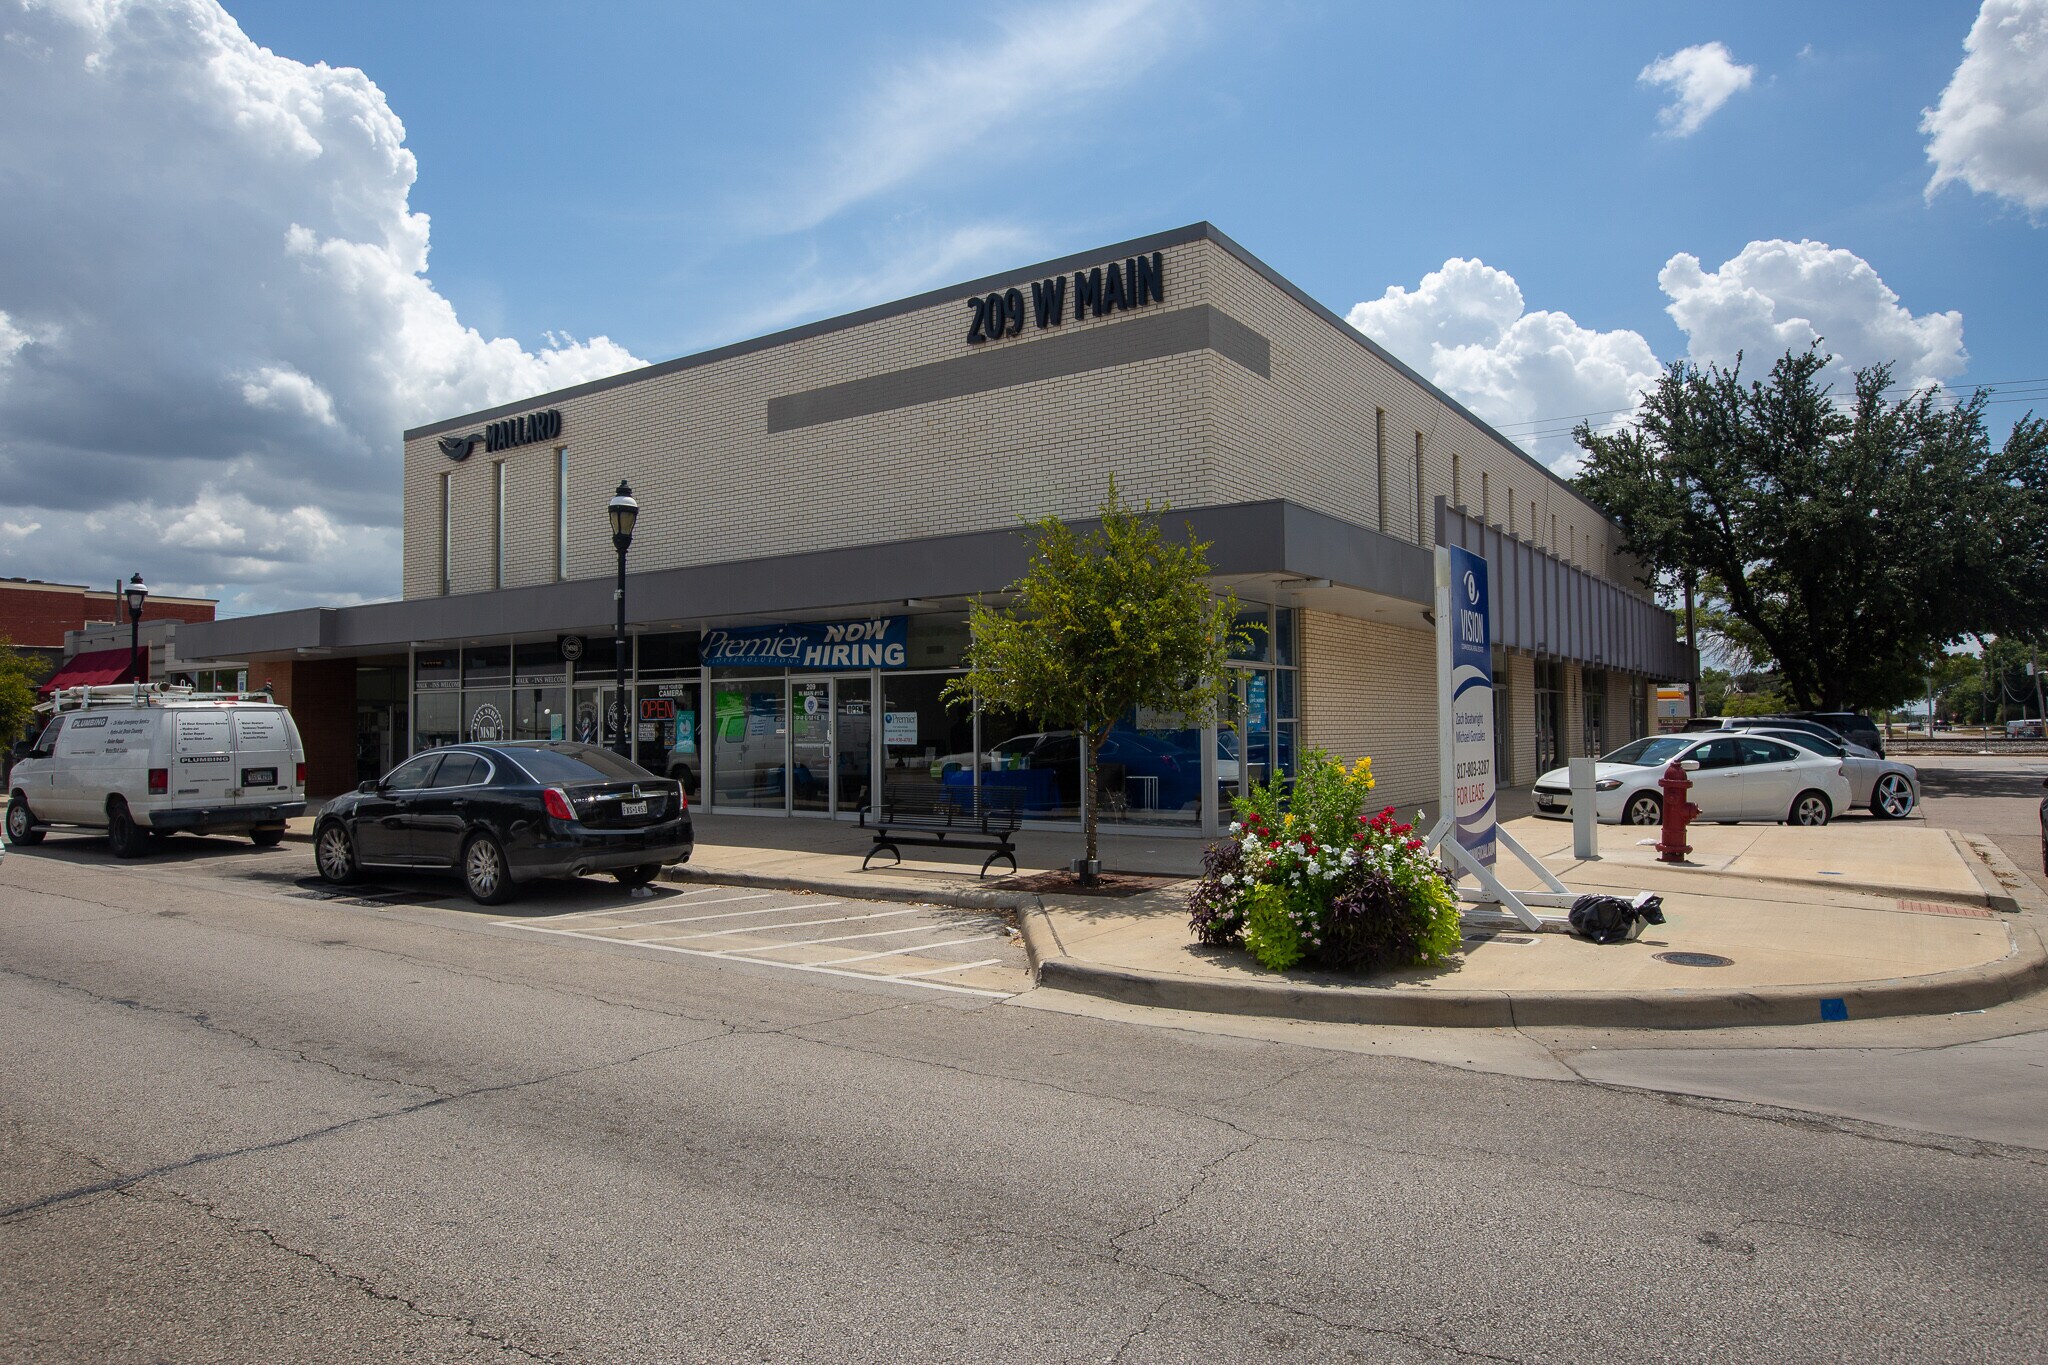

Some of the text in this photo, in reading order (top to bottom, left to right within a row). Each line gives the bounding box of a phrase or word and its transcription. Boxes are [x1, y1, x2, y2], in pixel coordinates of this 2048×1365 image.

[967, 251, 1164, 344] 209 W MAIN
[485, 408, 561, 453] MALLARD
[1460, 608, 1484, 644] VISION
[702, 619, 890, 659] Premier NOW
[803, 643, 905, 666] HIRING
[658, 689, 684, 697] CAMERA
[641, 700, 674, 719] OPEN
[848, 705, 863, 714] OPEN
[892, 714, 916, 724] Premier
[73, 718, 107, 728] PLUMBING
[1455, 713, 1483, 727] Zach Boatwright
[479, 726, 495, 739] MSB
[1456, 730, 1470, 743] Michael
[1456, 759, 1490, 780] 817-803-3287
[1456, 783, 1485, 806] FOR LEASE
